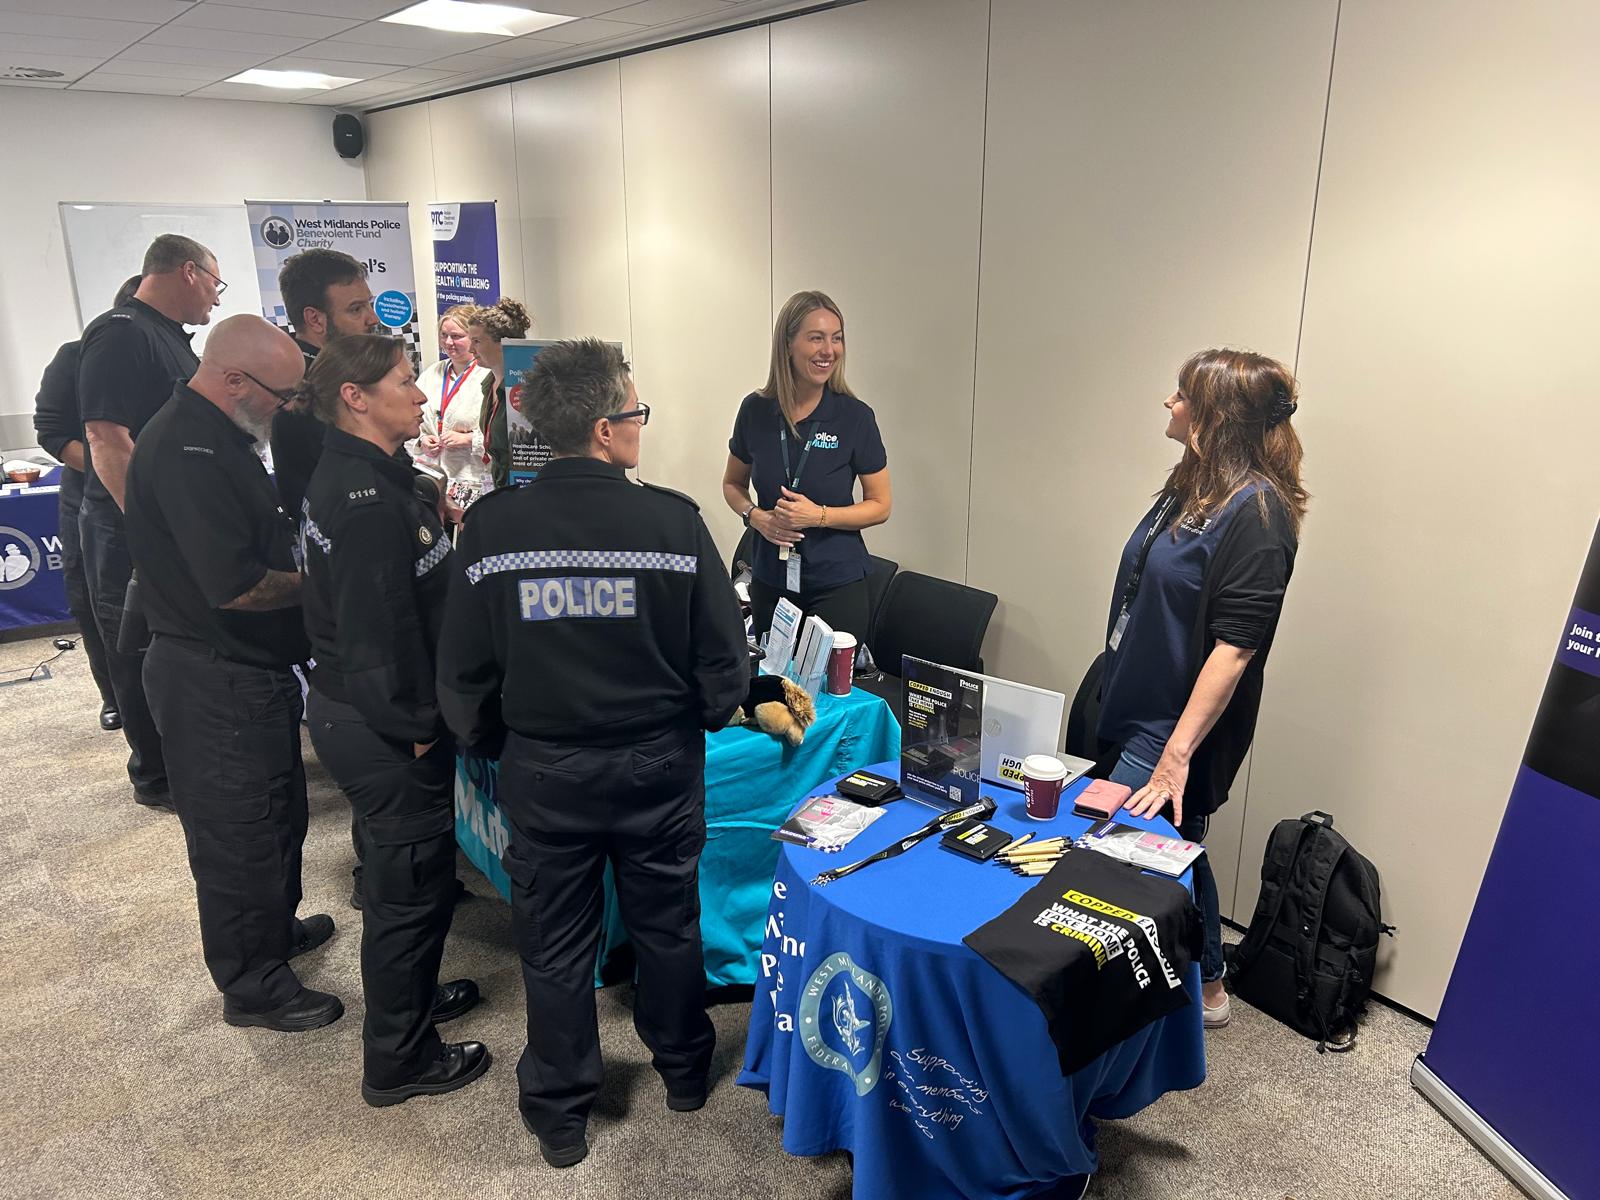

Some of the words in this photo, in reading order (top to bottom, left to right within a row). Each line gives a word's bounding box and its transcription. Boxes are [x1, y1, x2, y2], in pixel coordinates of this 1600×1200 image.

[295, 219, 322, 229] West
[324, 219, 369, 230] Midlands
[371, 219, 401, 230] Police
[297, 228, 354, 239] Benevolent
[356, 229, 382, 239] Fund
[297, 238, 334, 249] Charity
[468, 264, 478, 275] THE
[461, 278, 490, 290] WELLBEING
[815, 432, 838, 442] olice
[349, 488, 376, 500] 6116
[520, 580, 635, 619] POLICE
[1570, 624, 1594, 640] Join
[1566, 639, 1594, 656] your
[910, 681, 930, 691] COPPED
[930, 688, 951, 698] ENOUGH
[932, 699, 947, 708] POLICE
[1069, 892, 1135, 921] COPPED
[1044, 910, 1080, 932] TAKE
[1083, 924, 1120, 956] HOME
[1033, 916, 1050, 928] IS
[1051, 924, 1108, 972] CRIMINAL
[1052, 902, 1097, 926] WHAT
[1098, 920, 1130, 940] THE
[1123, 938, 1151, 990] POLICE
[808, 964, 834, 997] WEST
[838, 957, 885, 1002] MILANDS
[884, 1066, 896, 1080] in
